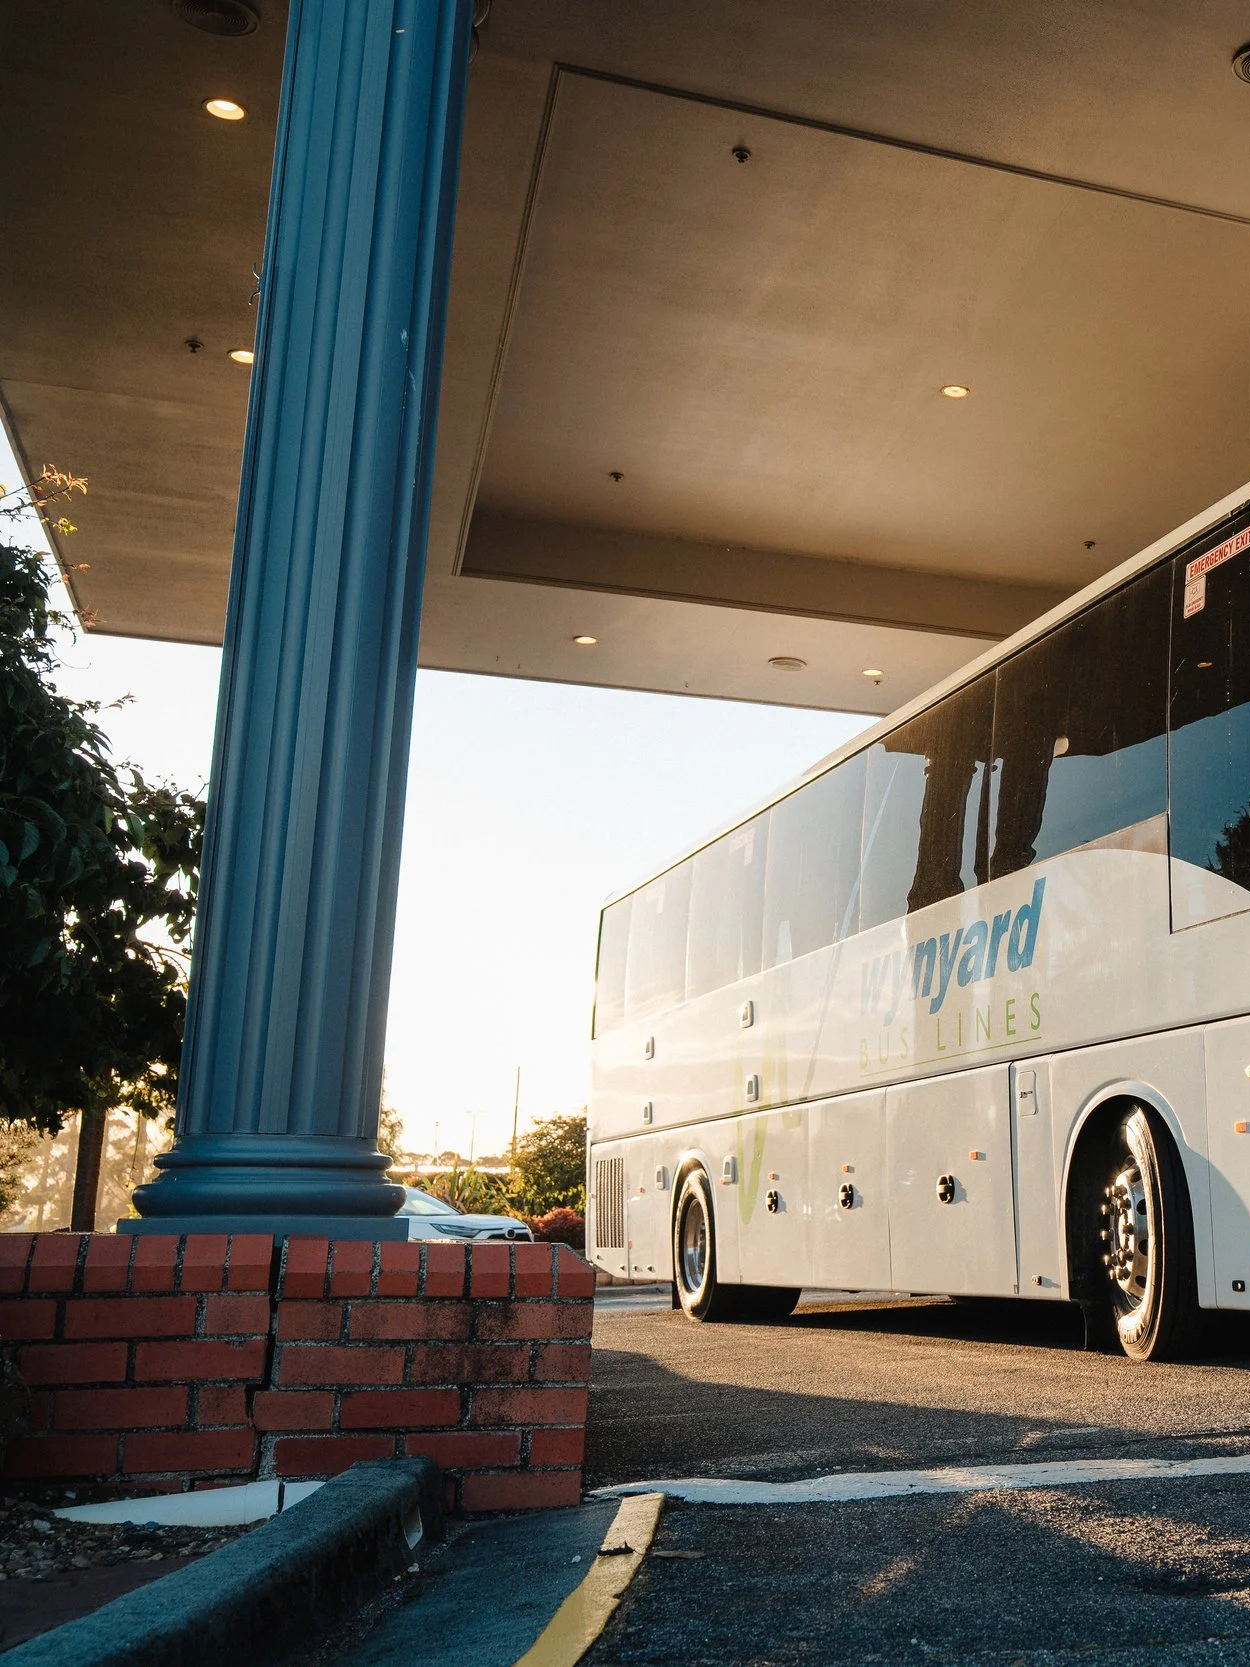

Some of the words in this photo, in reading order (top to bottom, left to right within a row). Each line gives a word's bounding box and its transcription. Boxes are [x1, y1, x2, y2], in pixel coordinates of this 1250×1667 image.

[1189, 540, 1233, 579] EMERGENCY
[861, 877, 1047, 1027] wynyard
[859, 1027, 908, 1070] BUS
[936, 992, 1041, 1052] LINES
